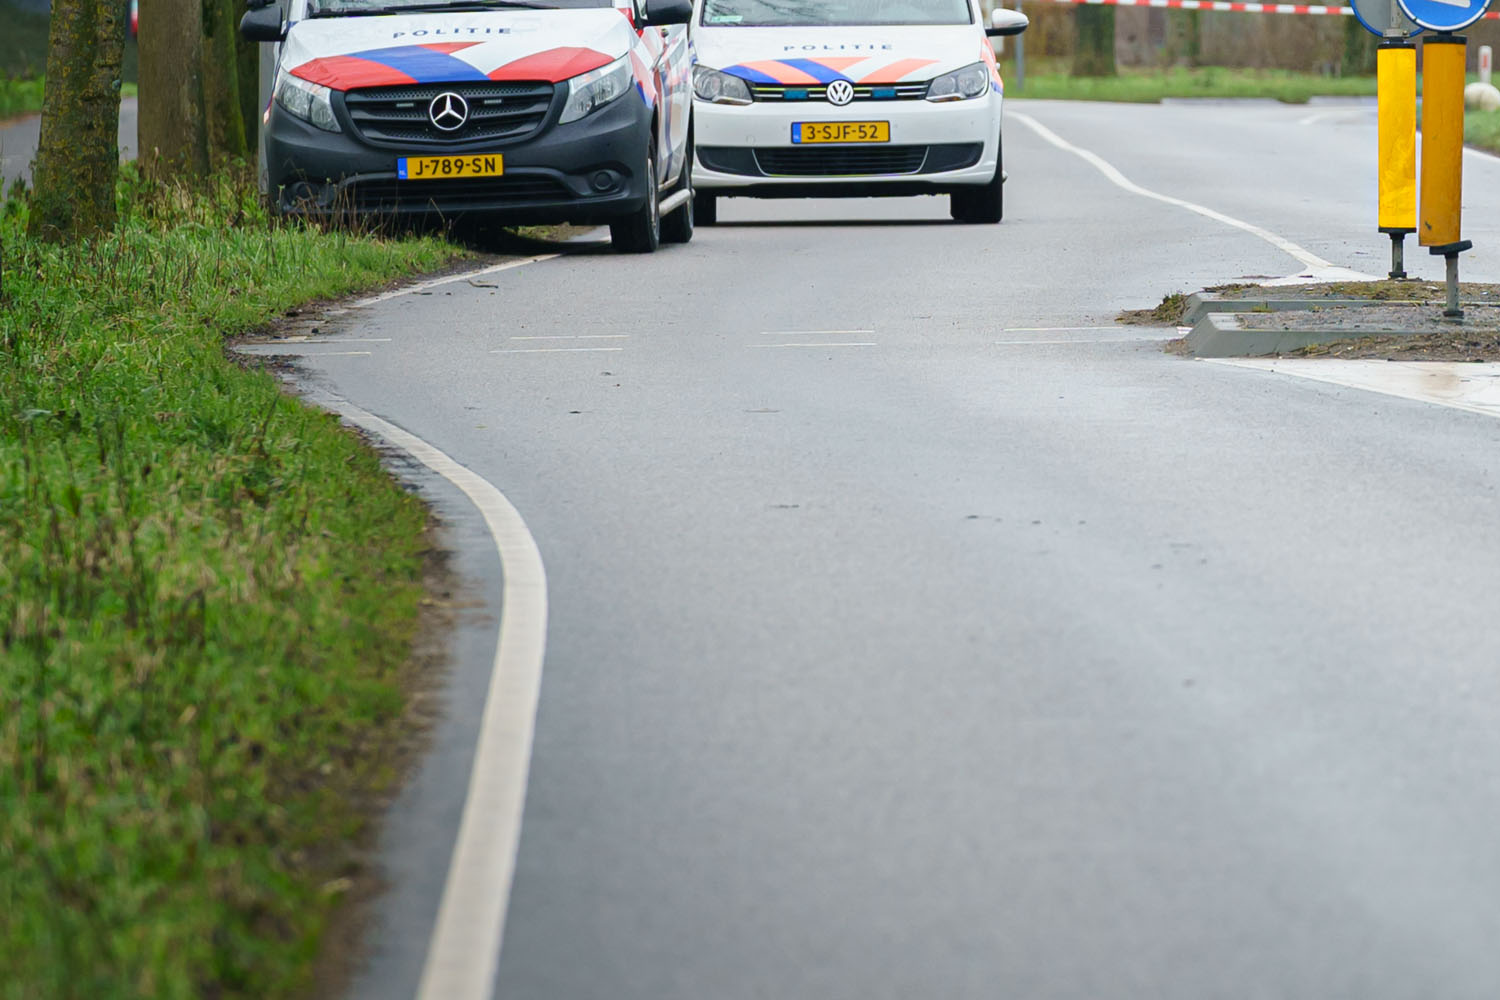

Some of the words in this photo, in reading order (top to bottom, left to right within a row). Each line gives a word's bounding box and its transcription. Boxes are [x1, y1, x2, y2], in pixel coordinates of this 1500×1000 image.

[393, 27, 511, 39] POLITIE
[807, 124, 879, 140] 3-SJF-52
[415, 157, 496, 176] J-789-SN
